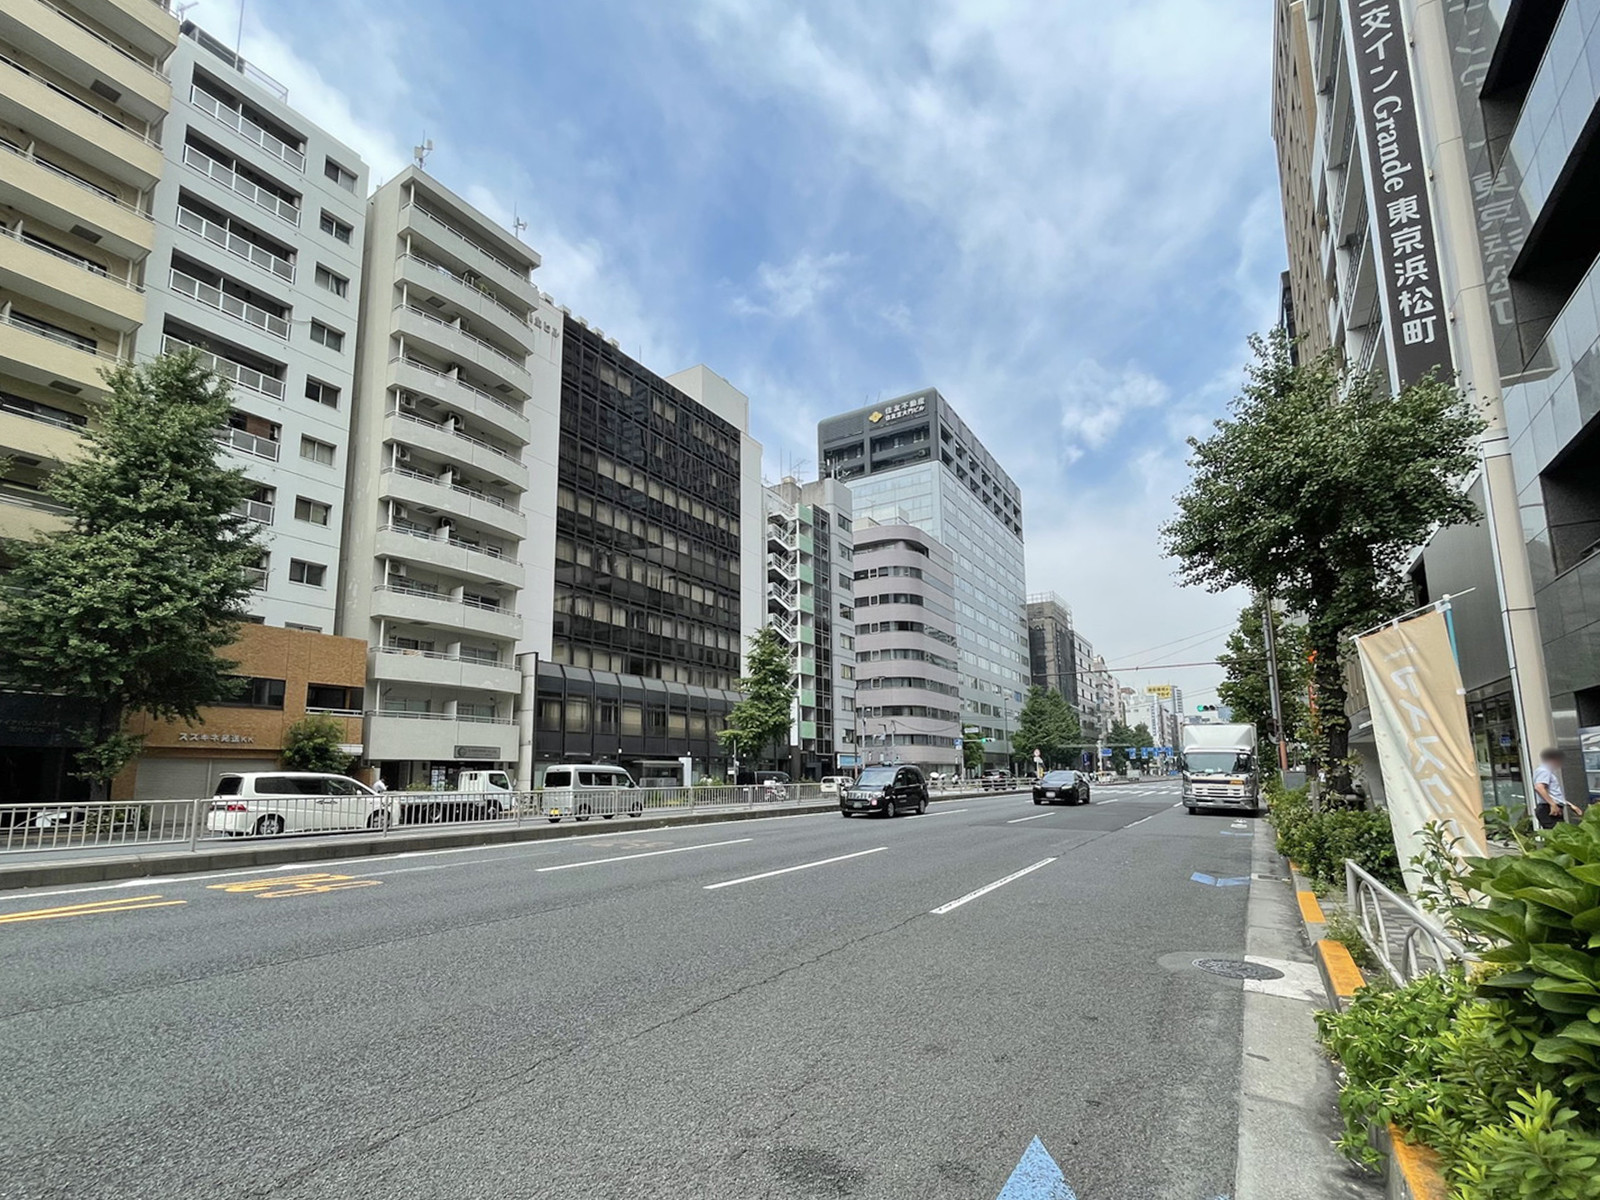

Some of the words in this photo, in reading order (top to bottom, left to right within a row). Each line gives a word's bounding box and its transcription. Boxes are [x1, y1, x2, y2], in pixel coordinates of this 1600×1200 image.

[1358, 0, 1399, 94] 交イン
[1372, 96, 1412, 194] Grande
[1386, 194, 1438, 346] 東京浜松町
[885, 397, 926, 414] 住友不動産
